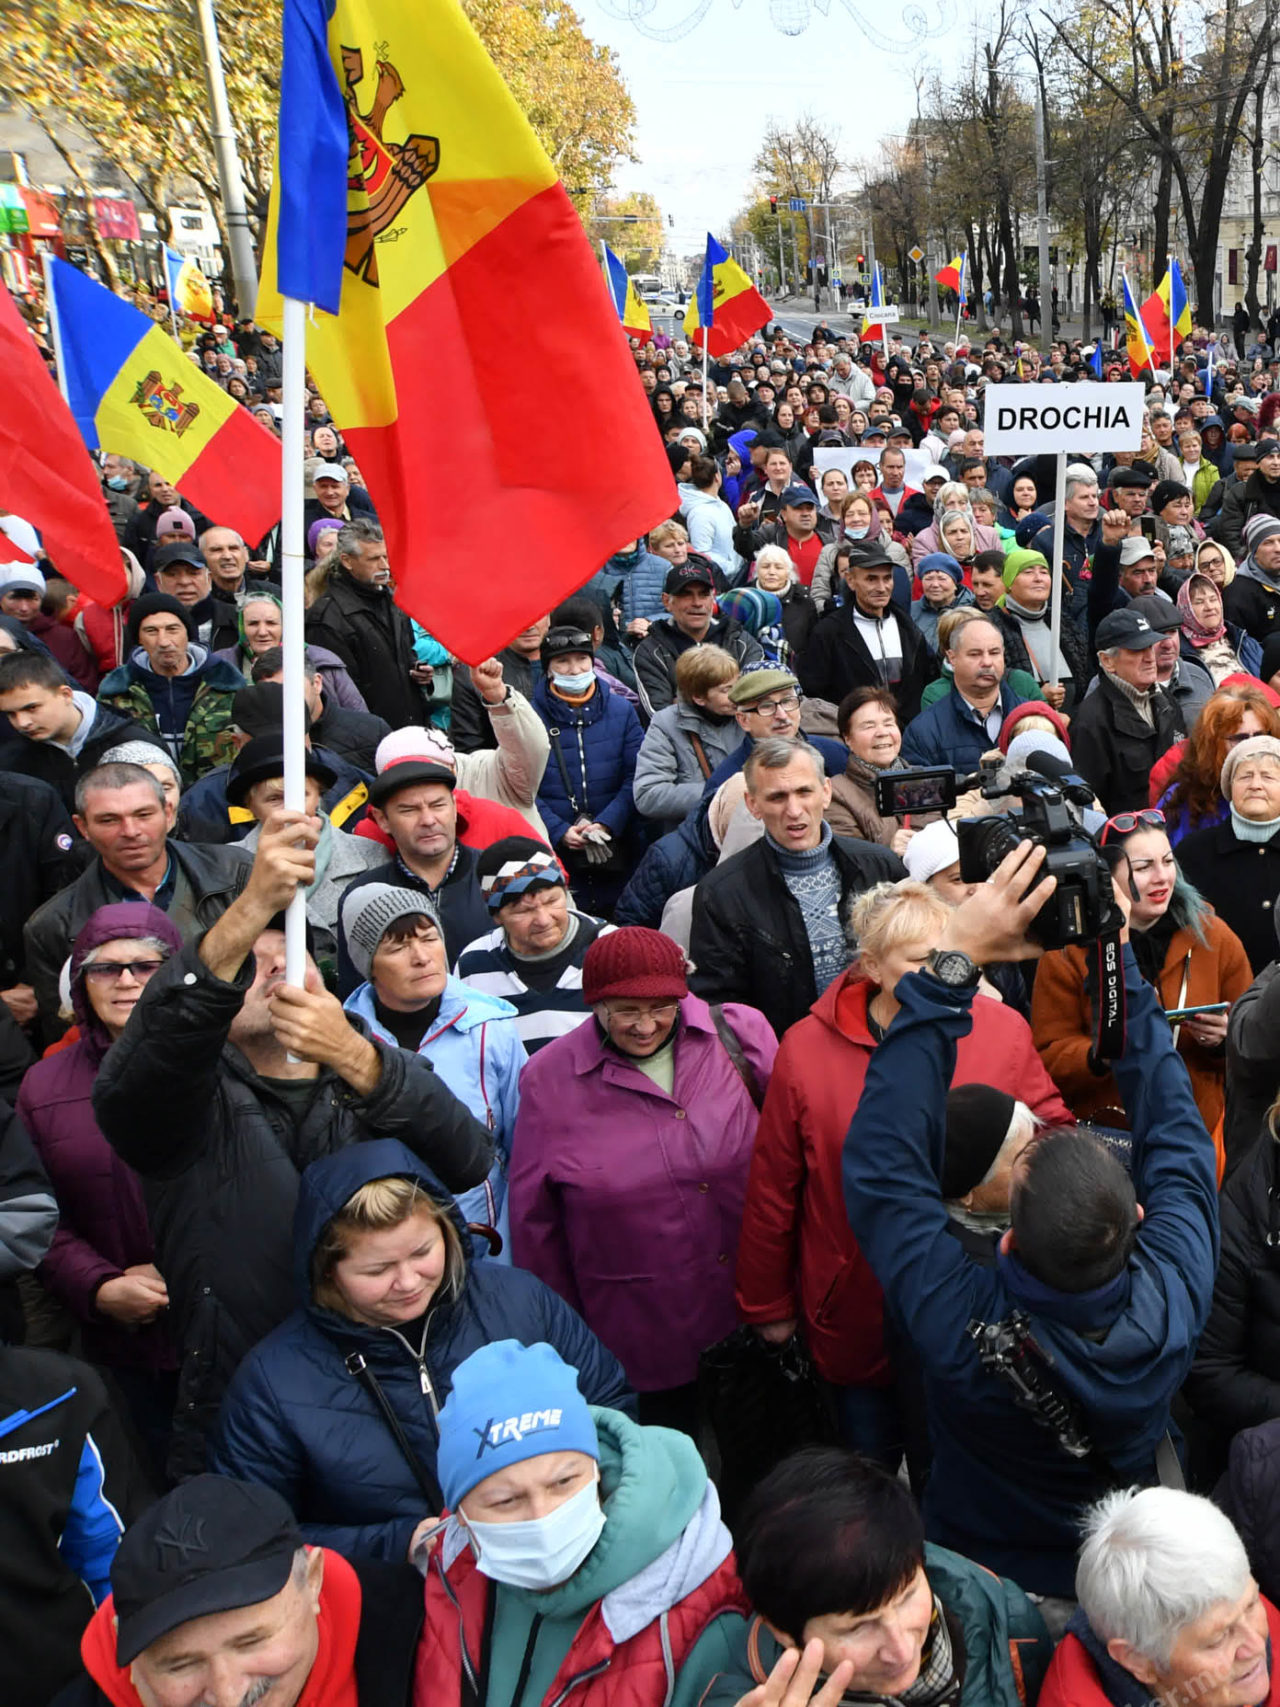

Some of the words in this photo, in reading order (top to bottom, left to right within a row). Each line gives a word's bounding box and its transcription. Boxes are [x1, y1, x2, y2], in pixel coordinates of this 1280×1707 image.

[998, 406, 1130, 430] DROCHIA
[1106, 942, 1116, 972] EOS
[1108, 975, 1118, 1028] DIGITAL
[472, 1407, 563, 1460] XTREME
